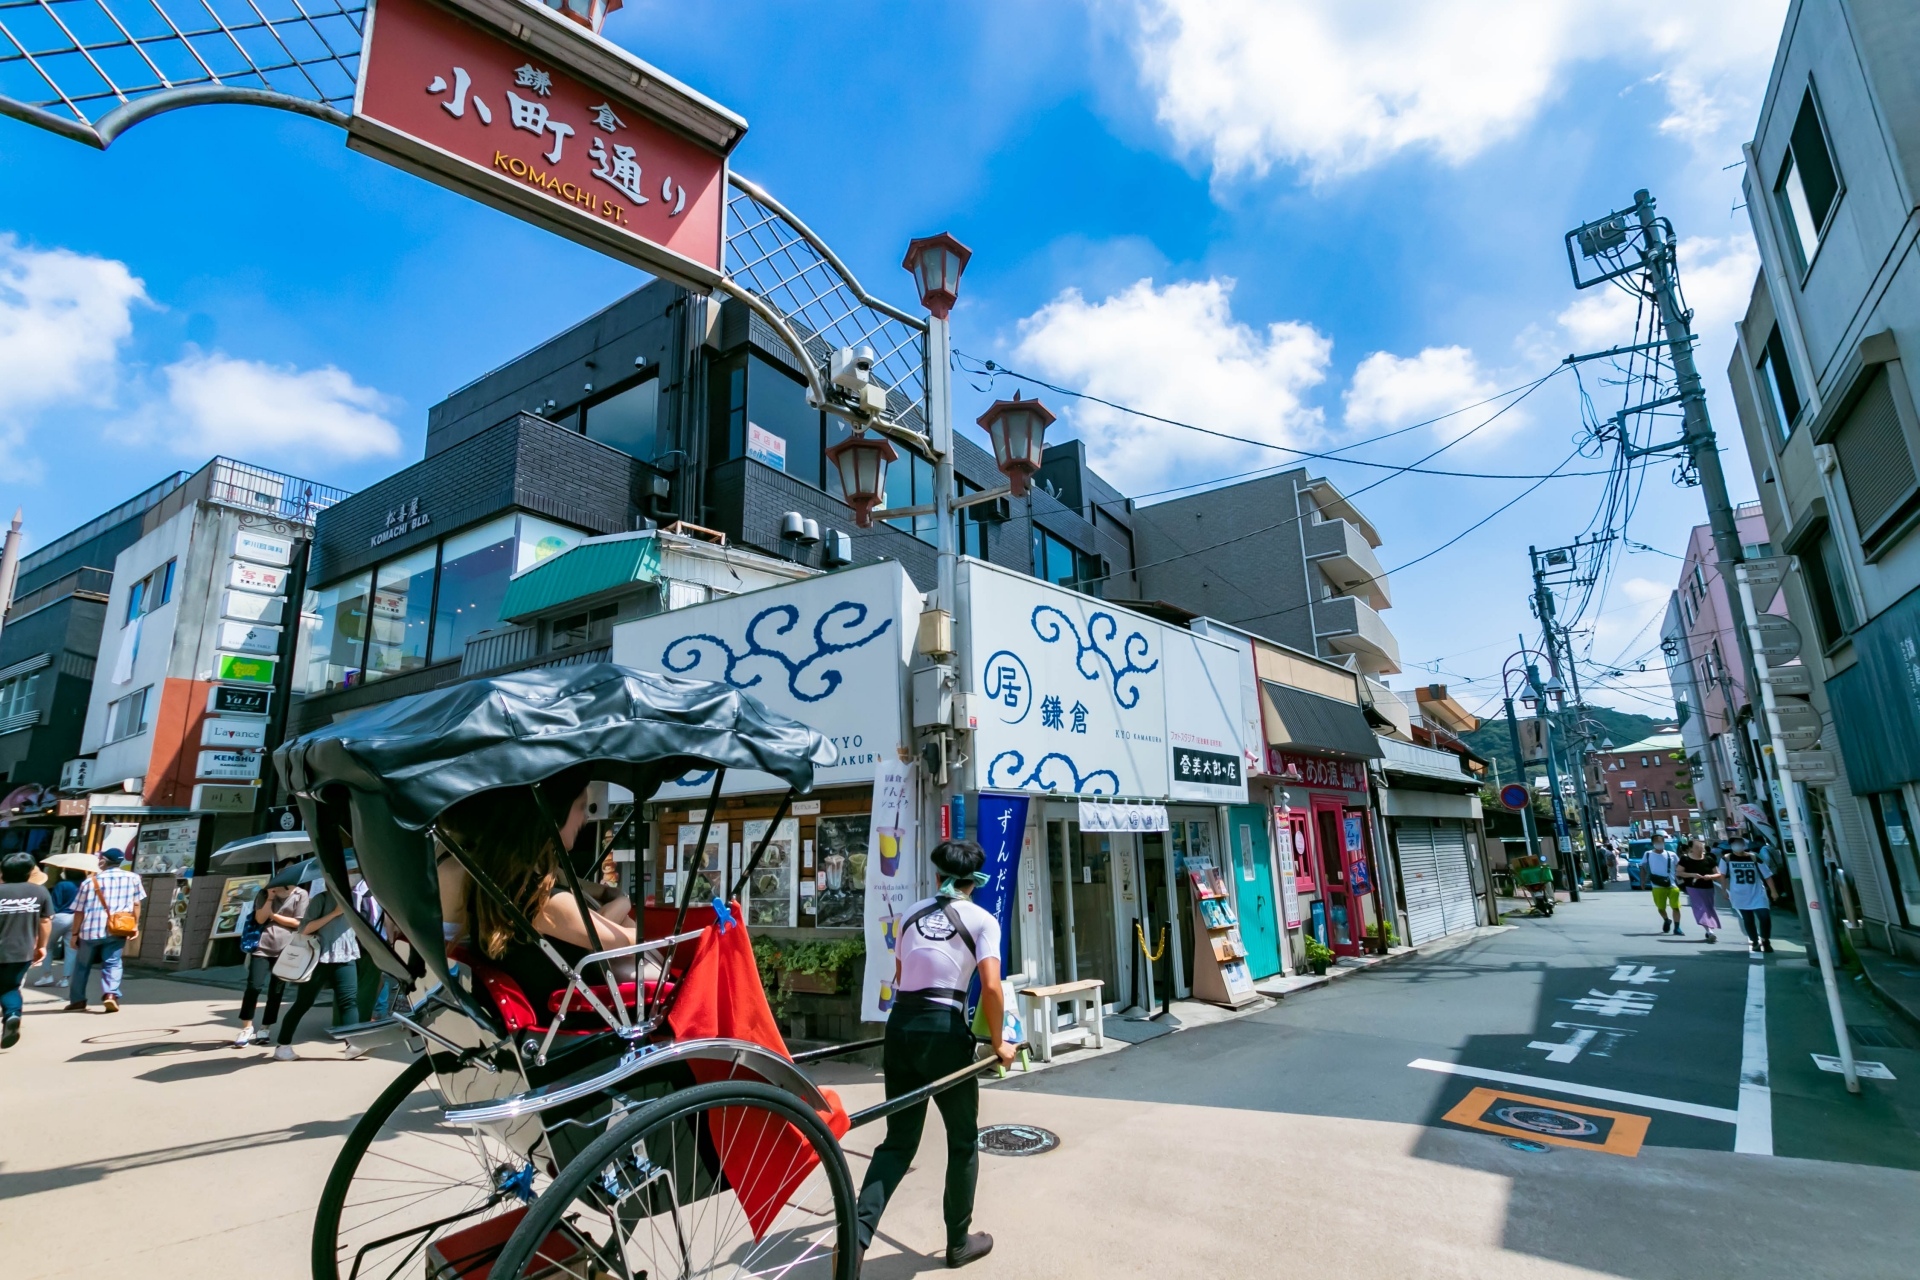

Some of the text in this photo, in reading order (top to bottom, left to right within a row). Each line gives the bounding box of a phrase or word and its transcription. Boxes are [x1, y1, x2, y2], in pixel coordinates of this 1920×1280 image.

[514, 63, 627, 133] 鎌倉
[426, 66, 687, 217] 小町通り
[494, 150, 629, 225] KOMACHI ST.
[370, 513, 430, 547] KOMACHI BLD.
[242, 569, 277, 583] 写真
[228, 640, 256, 648] KAMAKURA
[1900, 641, 1917, 694] KAMAKURA
[225, 694, 260, 706] Yu Li
[1040, 694, 1090, 735] 鎌倉
[1115, 729, 1162, 743] KYO KAMAKURA
[213, 754, 256, 763] KENSHU
[1180, 754, 1236, 779] 登美太郎の店
[1306, 757, 1340, 786] あめ源
[1345, 821, 1355, 847] ラムネ
[1734, 869, 1756, 885] 28
